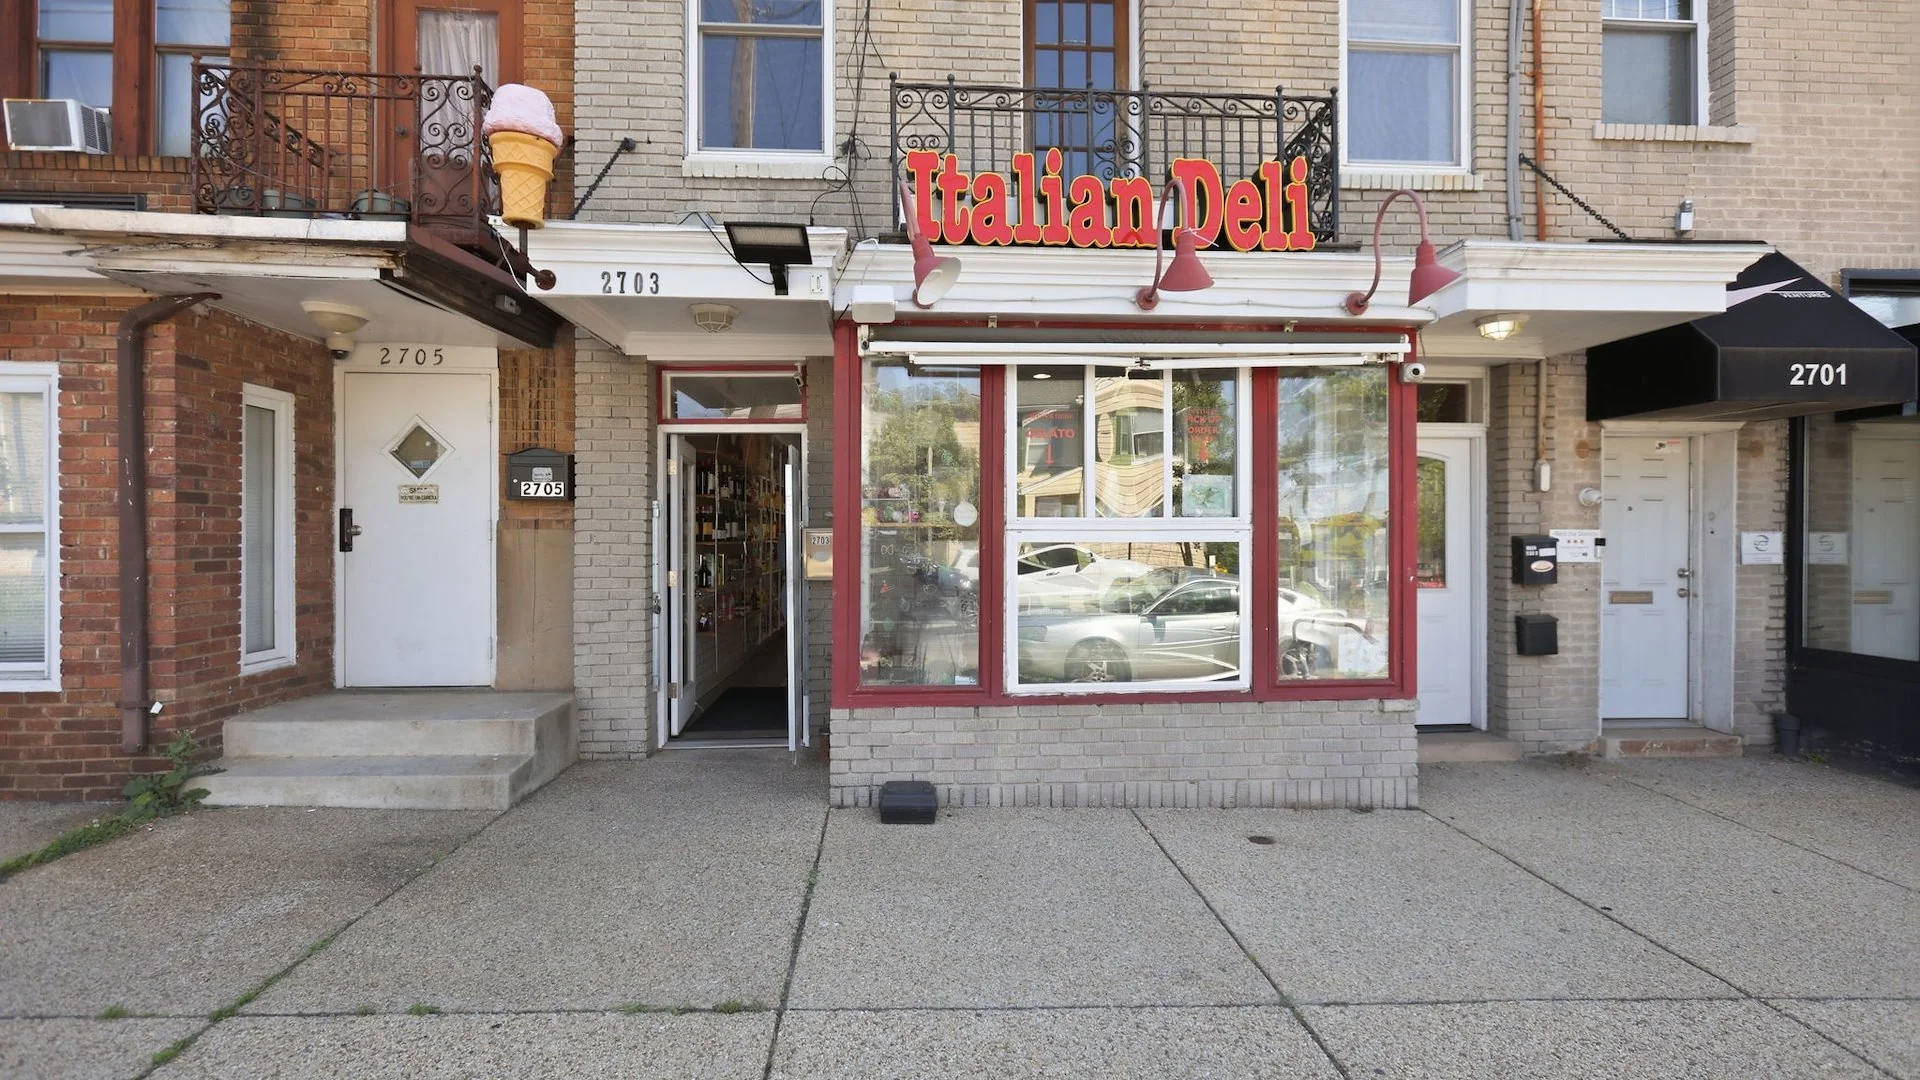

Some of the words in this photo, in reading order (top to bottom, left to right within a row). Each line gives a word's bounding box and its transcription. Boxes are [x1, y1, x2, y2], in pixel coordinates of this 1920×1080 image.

[905, 147, 1161, 249] Italian
[1171, 156, 1317, 252] Deli
[600, 271, 660, 295] 2703
[379, 347, 444, 366] 2705
[1789, 363, 1847, 386] 2701
[523, 482, 563, 496] 2705
[812, 536, 830, 545] 2703
